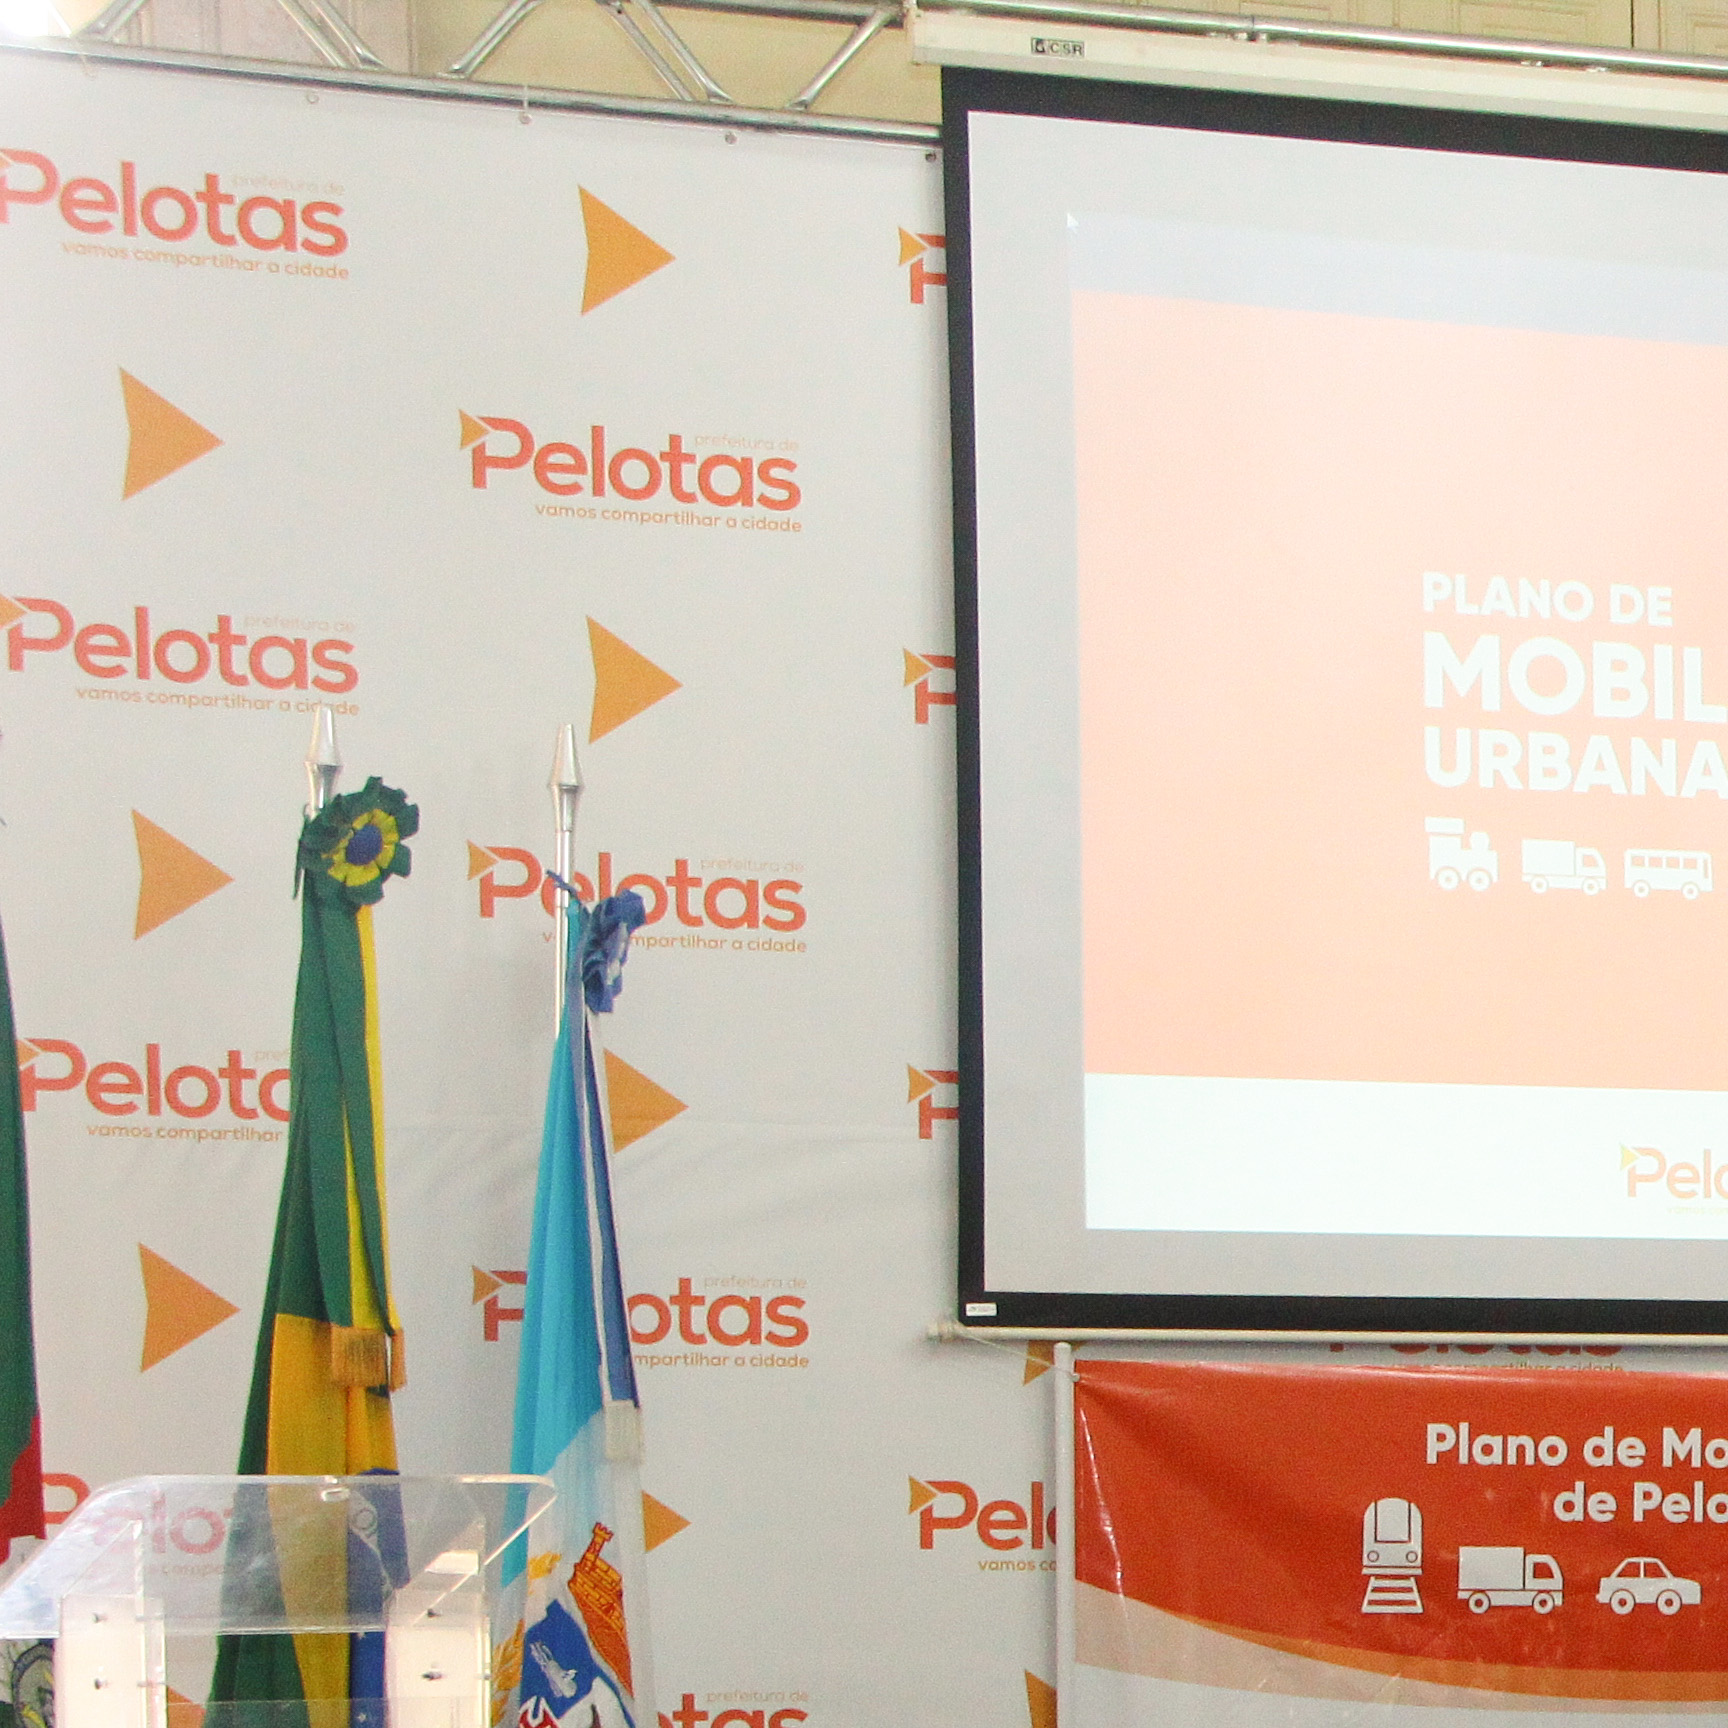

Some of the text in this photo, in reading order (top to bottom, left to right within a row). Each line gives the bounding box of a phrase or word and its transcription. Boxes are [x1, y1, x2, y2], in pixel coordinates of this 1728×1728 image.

[0, 149, 349, 257] Pelotas
[472, 416, 802, 512] Pelotas
[535, 503, 803, 533] vamos compartilhar a cidade
[1422, 571, 1674, 627] PLANO DE
[8, 597, 359, 694] Pelotas
[731, 938, 743, 951] a
[747, 936, 807, 953] cidade
[86, 1124, 283, 1144] vamos compartilhar
[734, 1356, 745, 1367] a
[750, 1353, 810, 1368] cidade
[1426, 1422, 1568, 1466] Plano
[1583, 1426, 1645, 1468] de
[1553, 1481, 1617, 1523] de
[978, 1559, 1035, 1572] vamos
